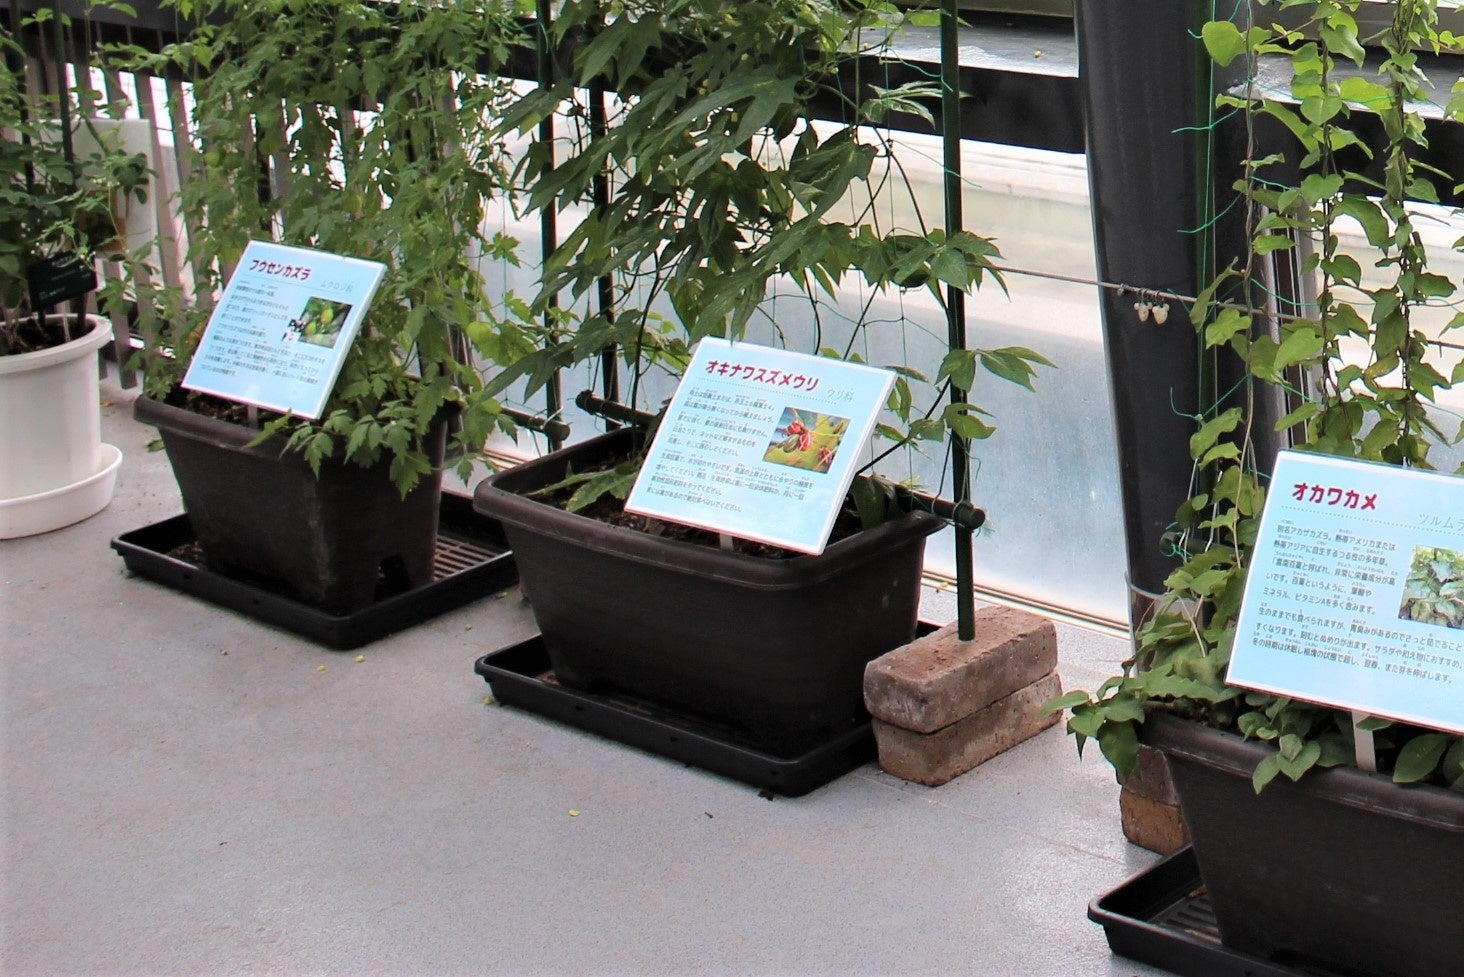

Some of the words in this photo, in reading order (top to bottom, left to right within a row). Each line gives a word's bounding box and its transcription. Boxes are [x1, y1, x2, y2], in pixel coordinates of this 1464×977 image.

[249, 259, 312, 281] フウセンカズラ
[705, 359, 819, 392] オキナワスズメウリ
[827, 388, 854, 402] ウリ科
[1291, 482, 1379, 511] オカワカメ
